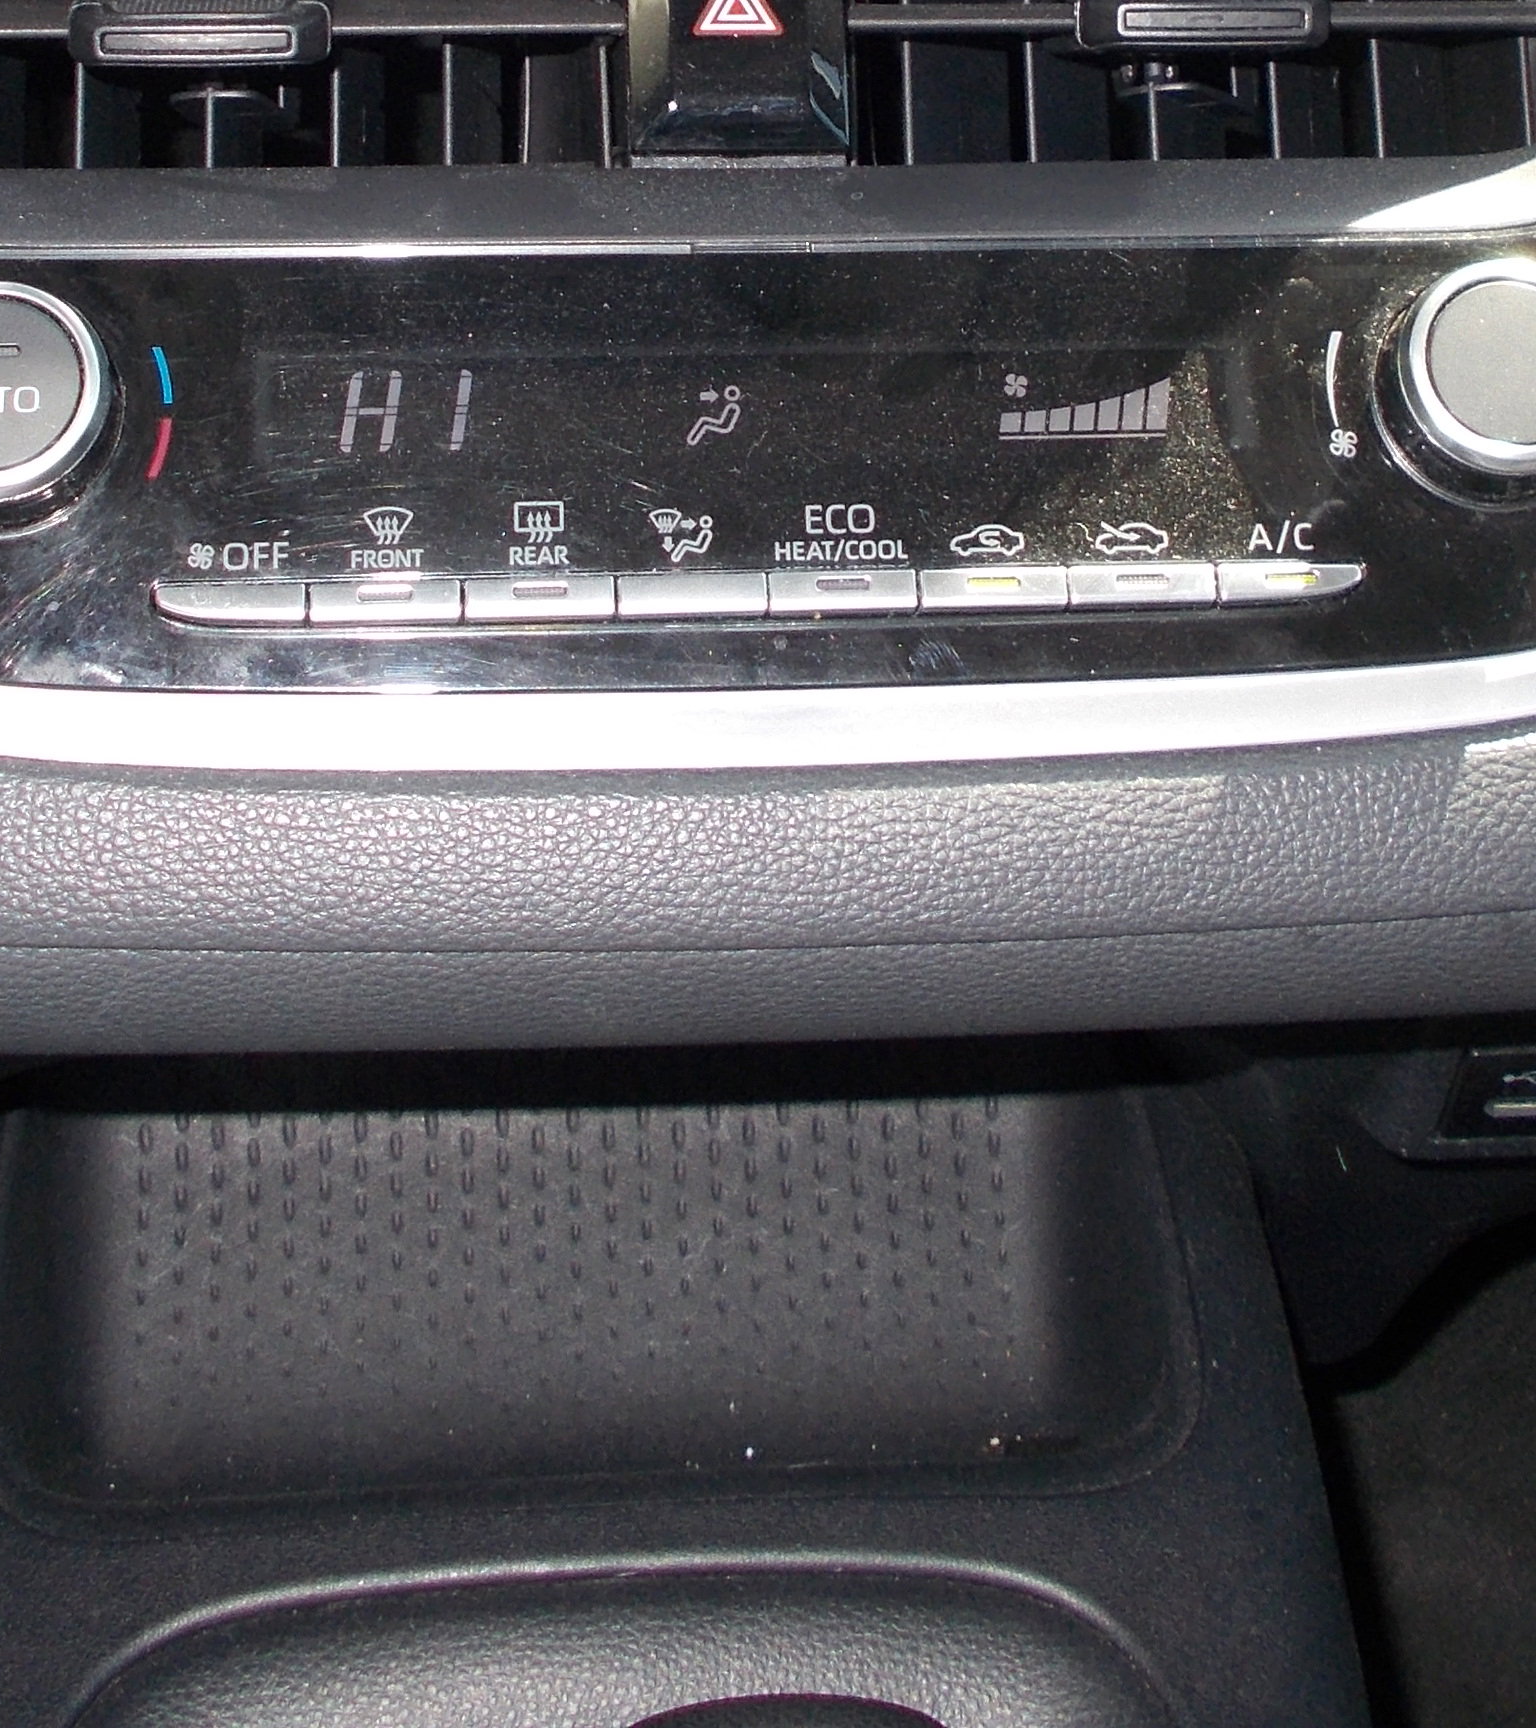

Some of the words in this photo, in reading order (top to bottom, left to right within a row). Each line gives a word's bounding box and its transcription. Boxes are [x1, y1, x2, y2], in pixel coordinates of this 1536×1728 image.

[804, 503, 876, 535] ECO
[1247, 518, 1314, 554] A/C
[222, 541, 290, 572] OFF
[350, 548, 424, 570] FRONT
[507, 544, 570, 567] REAR
[774, 538, 910, 562] HEAT/COOL
